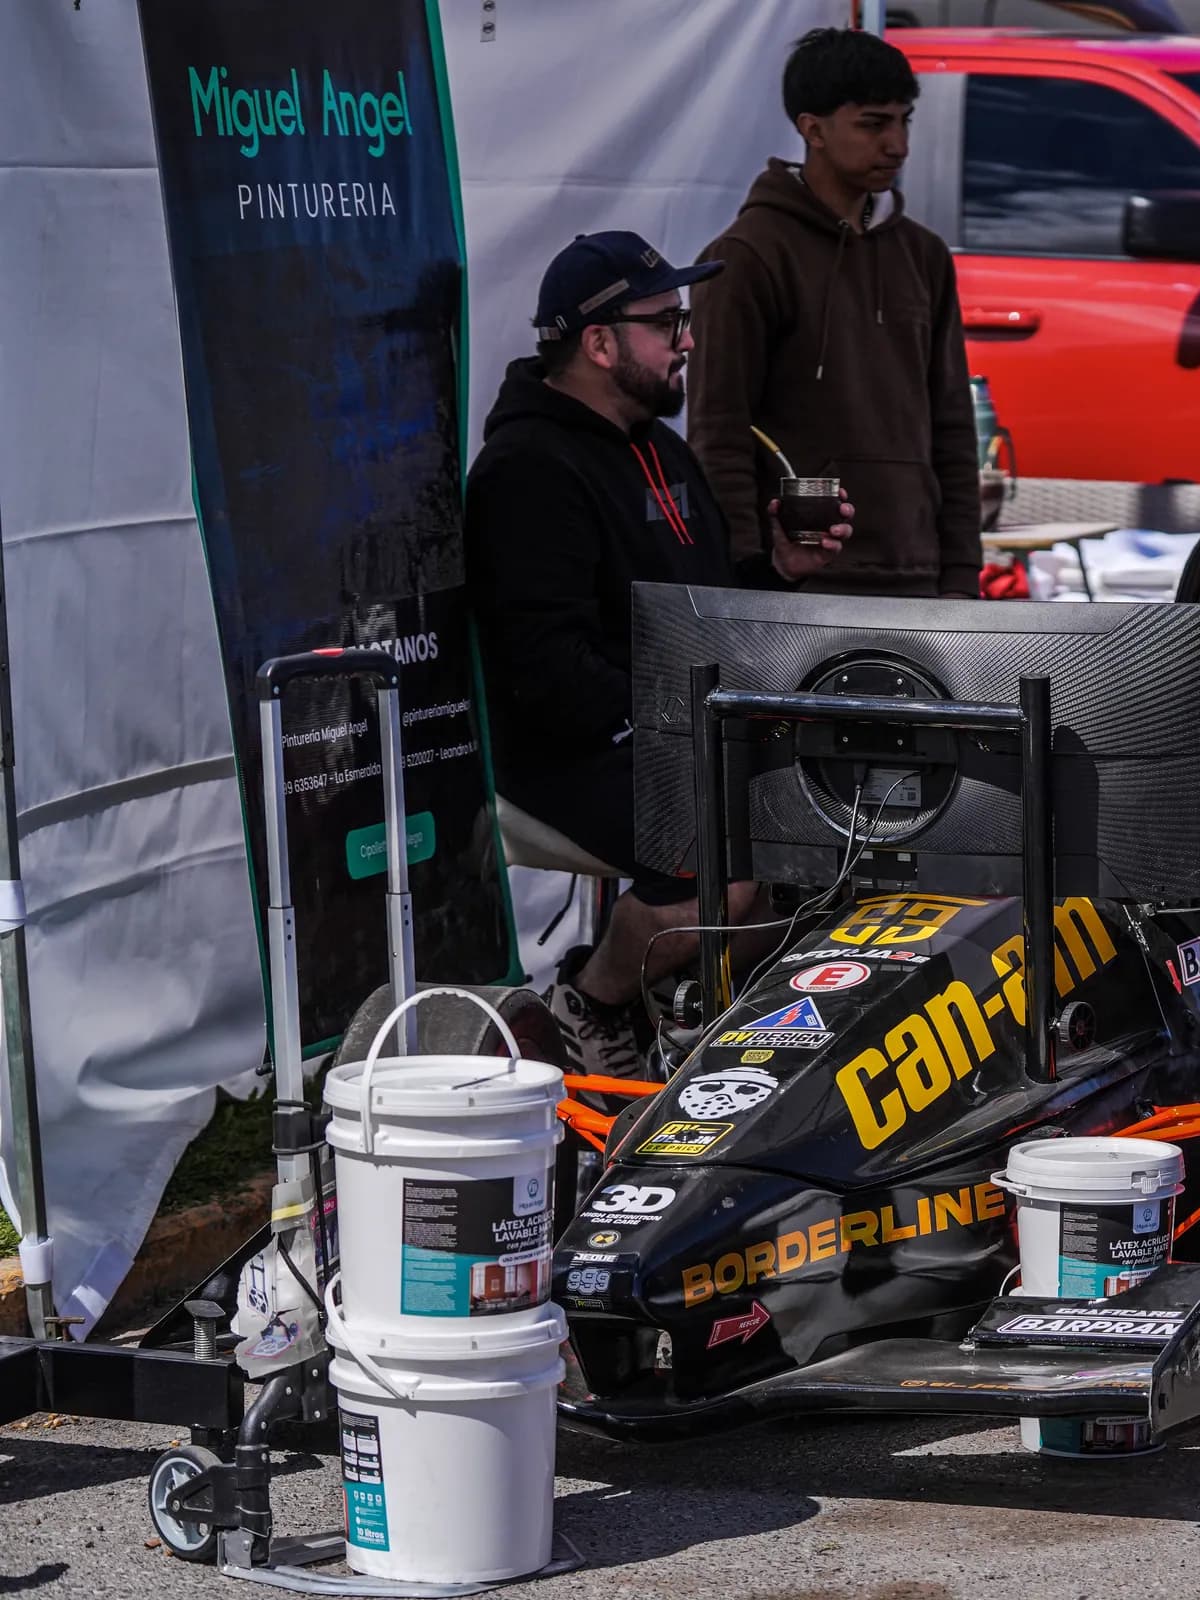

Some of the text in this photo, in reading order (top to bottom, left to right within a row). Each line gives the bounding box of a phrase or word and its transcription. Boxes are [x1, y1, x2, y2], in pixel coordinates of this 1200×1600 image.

[188, 66, 413, 158] Miguel Angel
[238, 182, 396, 219] PINTURERIA
[321, 724, 348, 743] Miguel
[294, 774, 328, 792] 6353647
[345, 762, 382, 782] Esmeralda
[718, 1031, 755, 1043] DV
[753, 1032, 827, 1044] DESIGN
[592, 1184, 676, 1213] 3D
[607, 1213, 662, 1221] DEFINITION
[492, 1218, 525, 1233] LÁTEX
[495, 1227, 538, 1242] LAVABLE
[682, 1182, 1006, 1308] BORDERLINE
[1109, 1239, 1139, 1250] LÁTEX
[1112, 1246, 1152, 1258] LAVABLE
[567, 1268, 611, 1295] 999
[1055, 1308, 1185, 1319] GRAFICARS
[1012, 1319, 1182, 1335] BARPRAN
